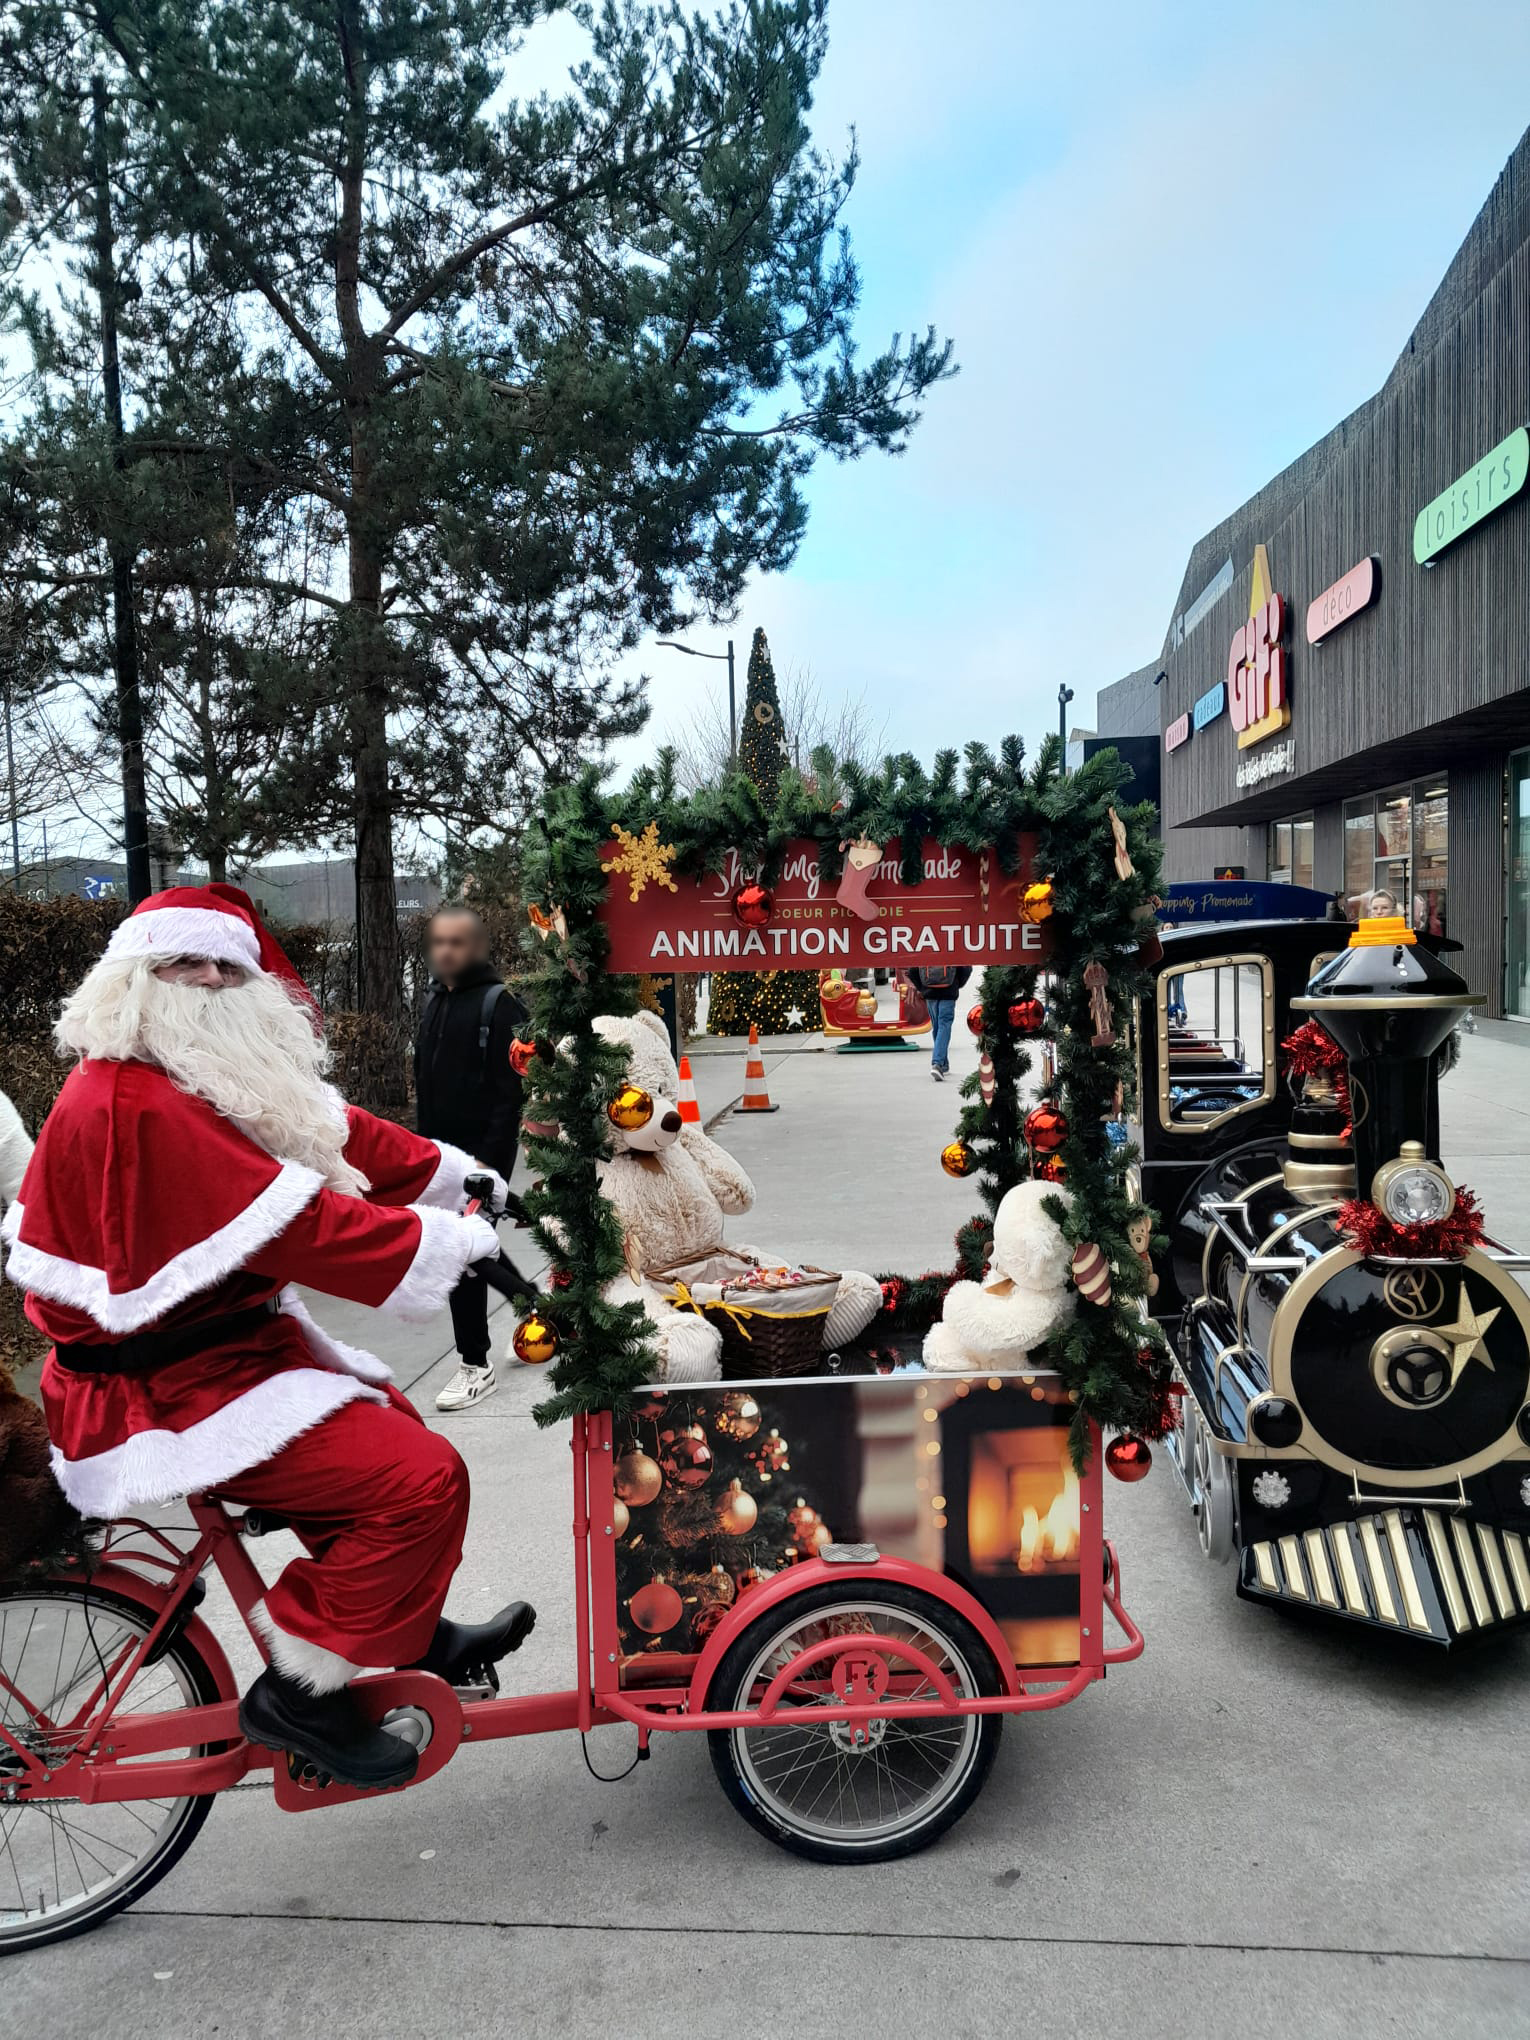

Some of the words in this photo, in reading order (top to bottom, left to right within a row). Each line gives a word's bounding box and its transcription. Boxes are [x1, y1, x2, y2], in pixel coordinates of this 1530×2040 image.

[1426, 455, 1511, 549] loisirs
[1323, 584, 1352, 626] déco
[1228, 593, 1283, 733] GiFi
[830, 906, 904, 919] PICDIE
[1200, 892, 1254, 913] Promenade
[649, 927, 850, 957] ANIMATION
[863, 923, 1043, 954] GRATUITE
